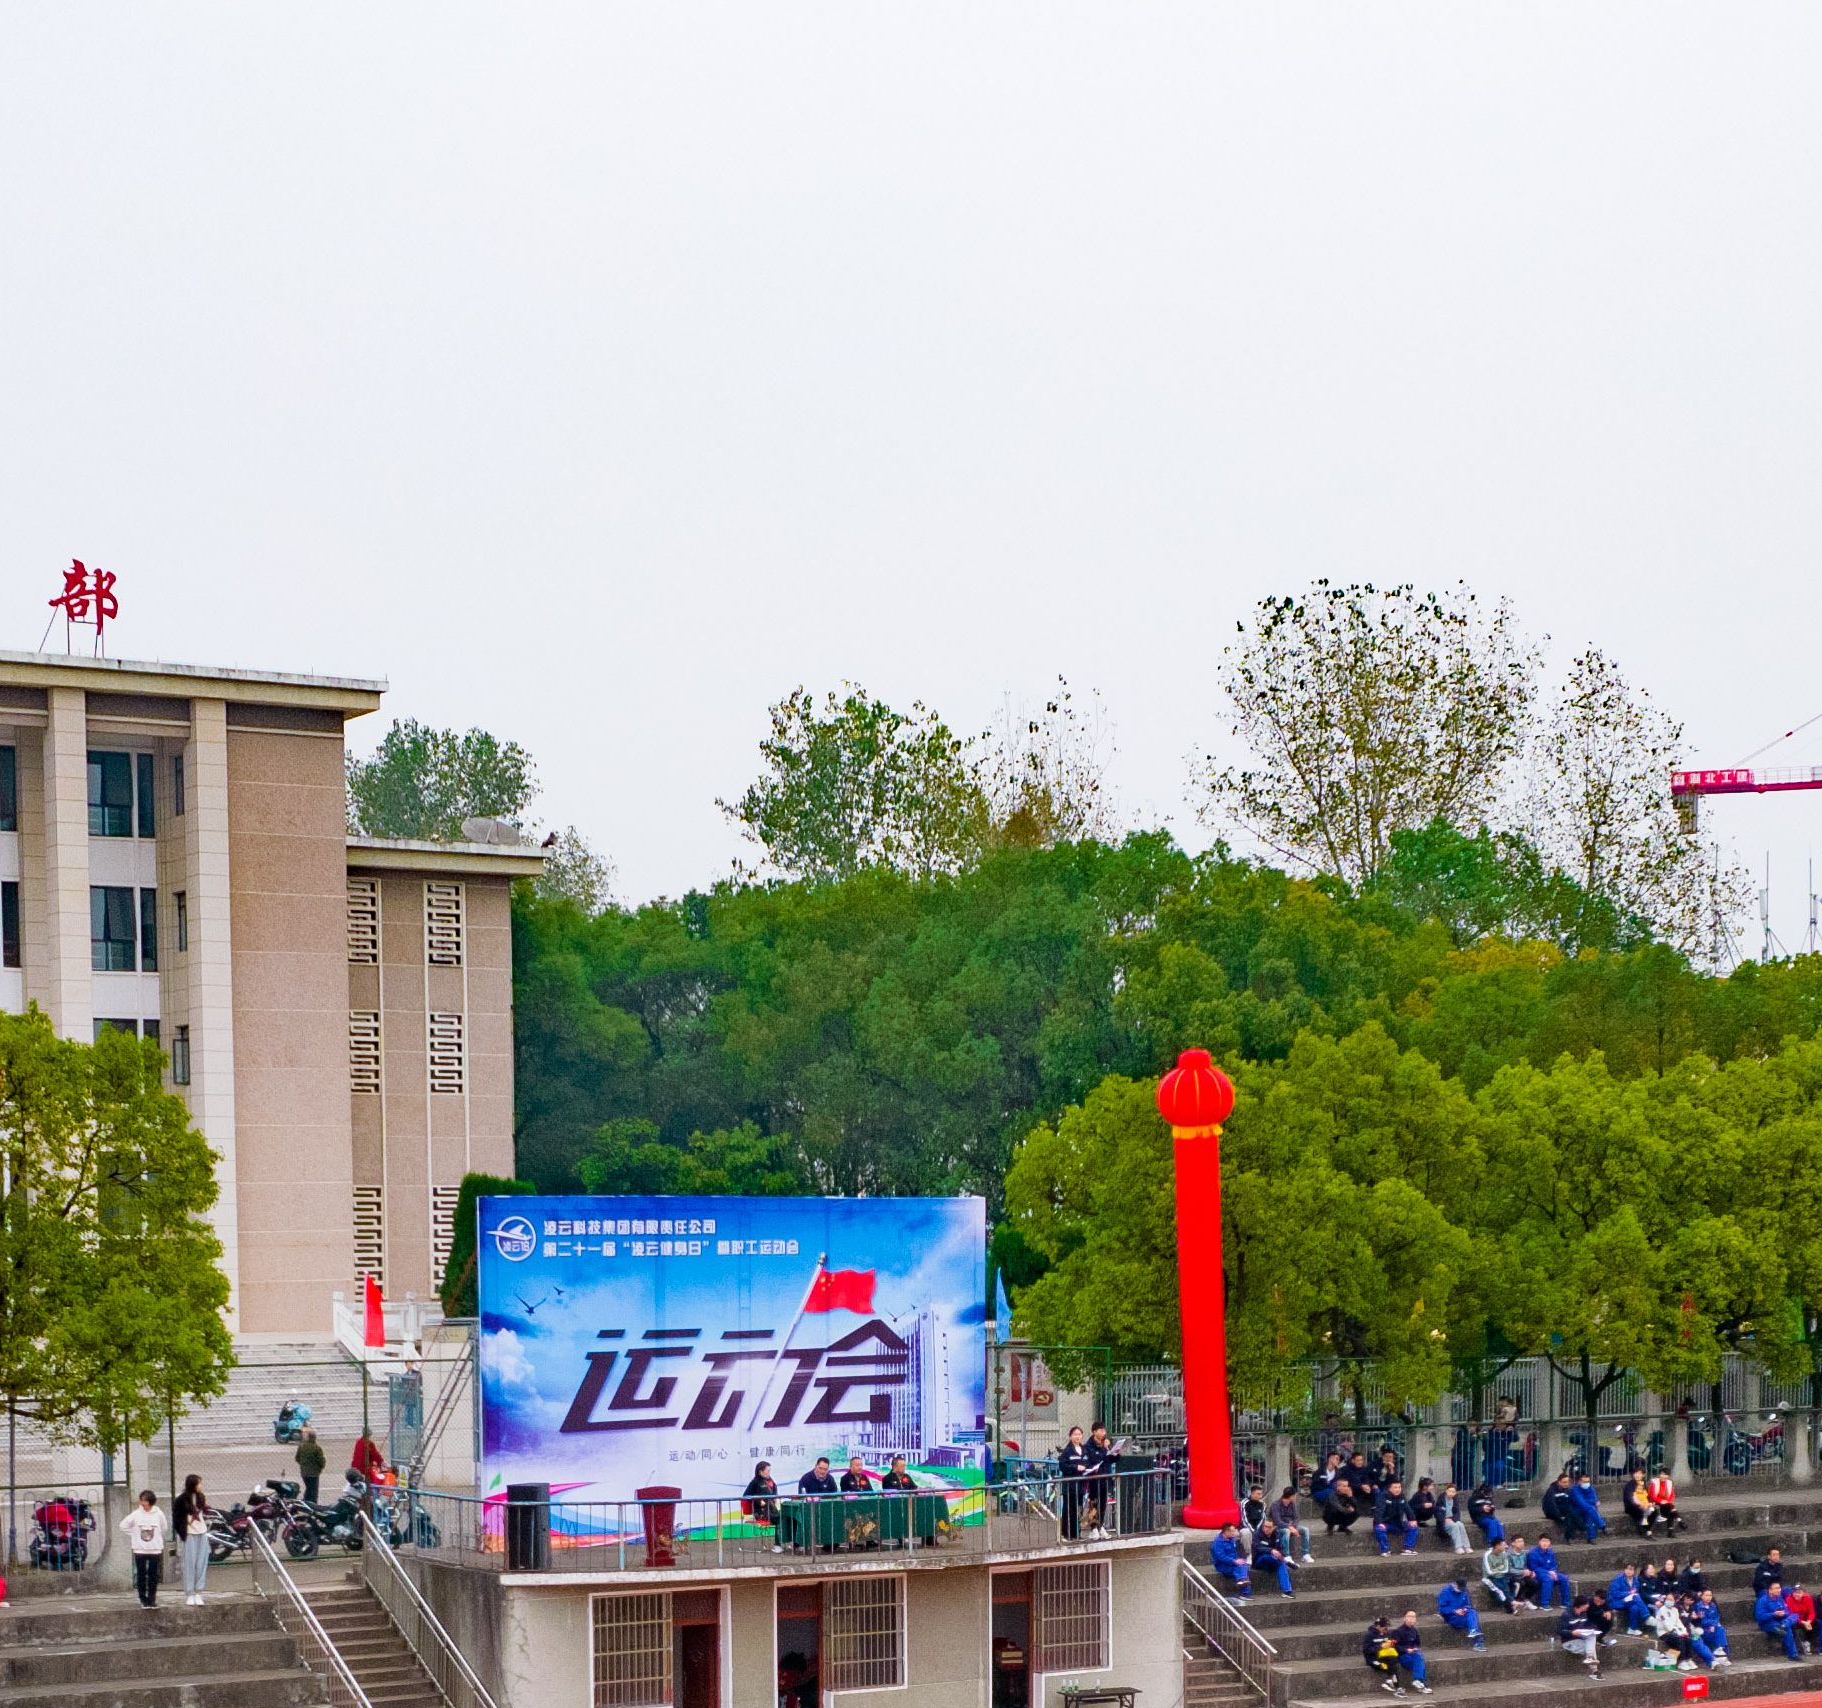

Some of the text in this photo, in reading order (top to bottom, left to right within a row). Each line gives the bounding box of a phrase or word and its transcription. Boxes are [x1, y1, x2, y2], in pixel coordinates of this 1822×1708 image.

[543, 1219, 716, 1236] 凌云科技集团有限责任公司
[560, 1319, 910, 1433] 运动会
